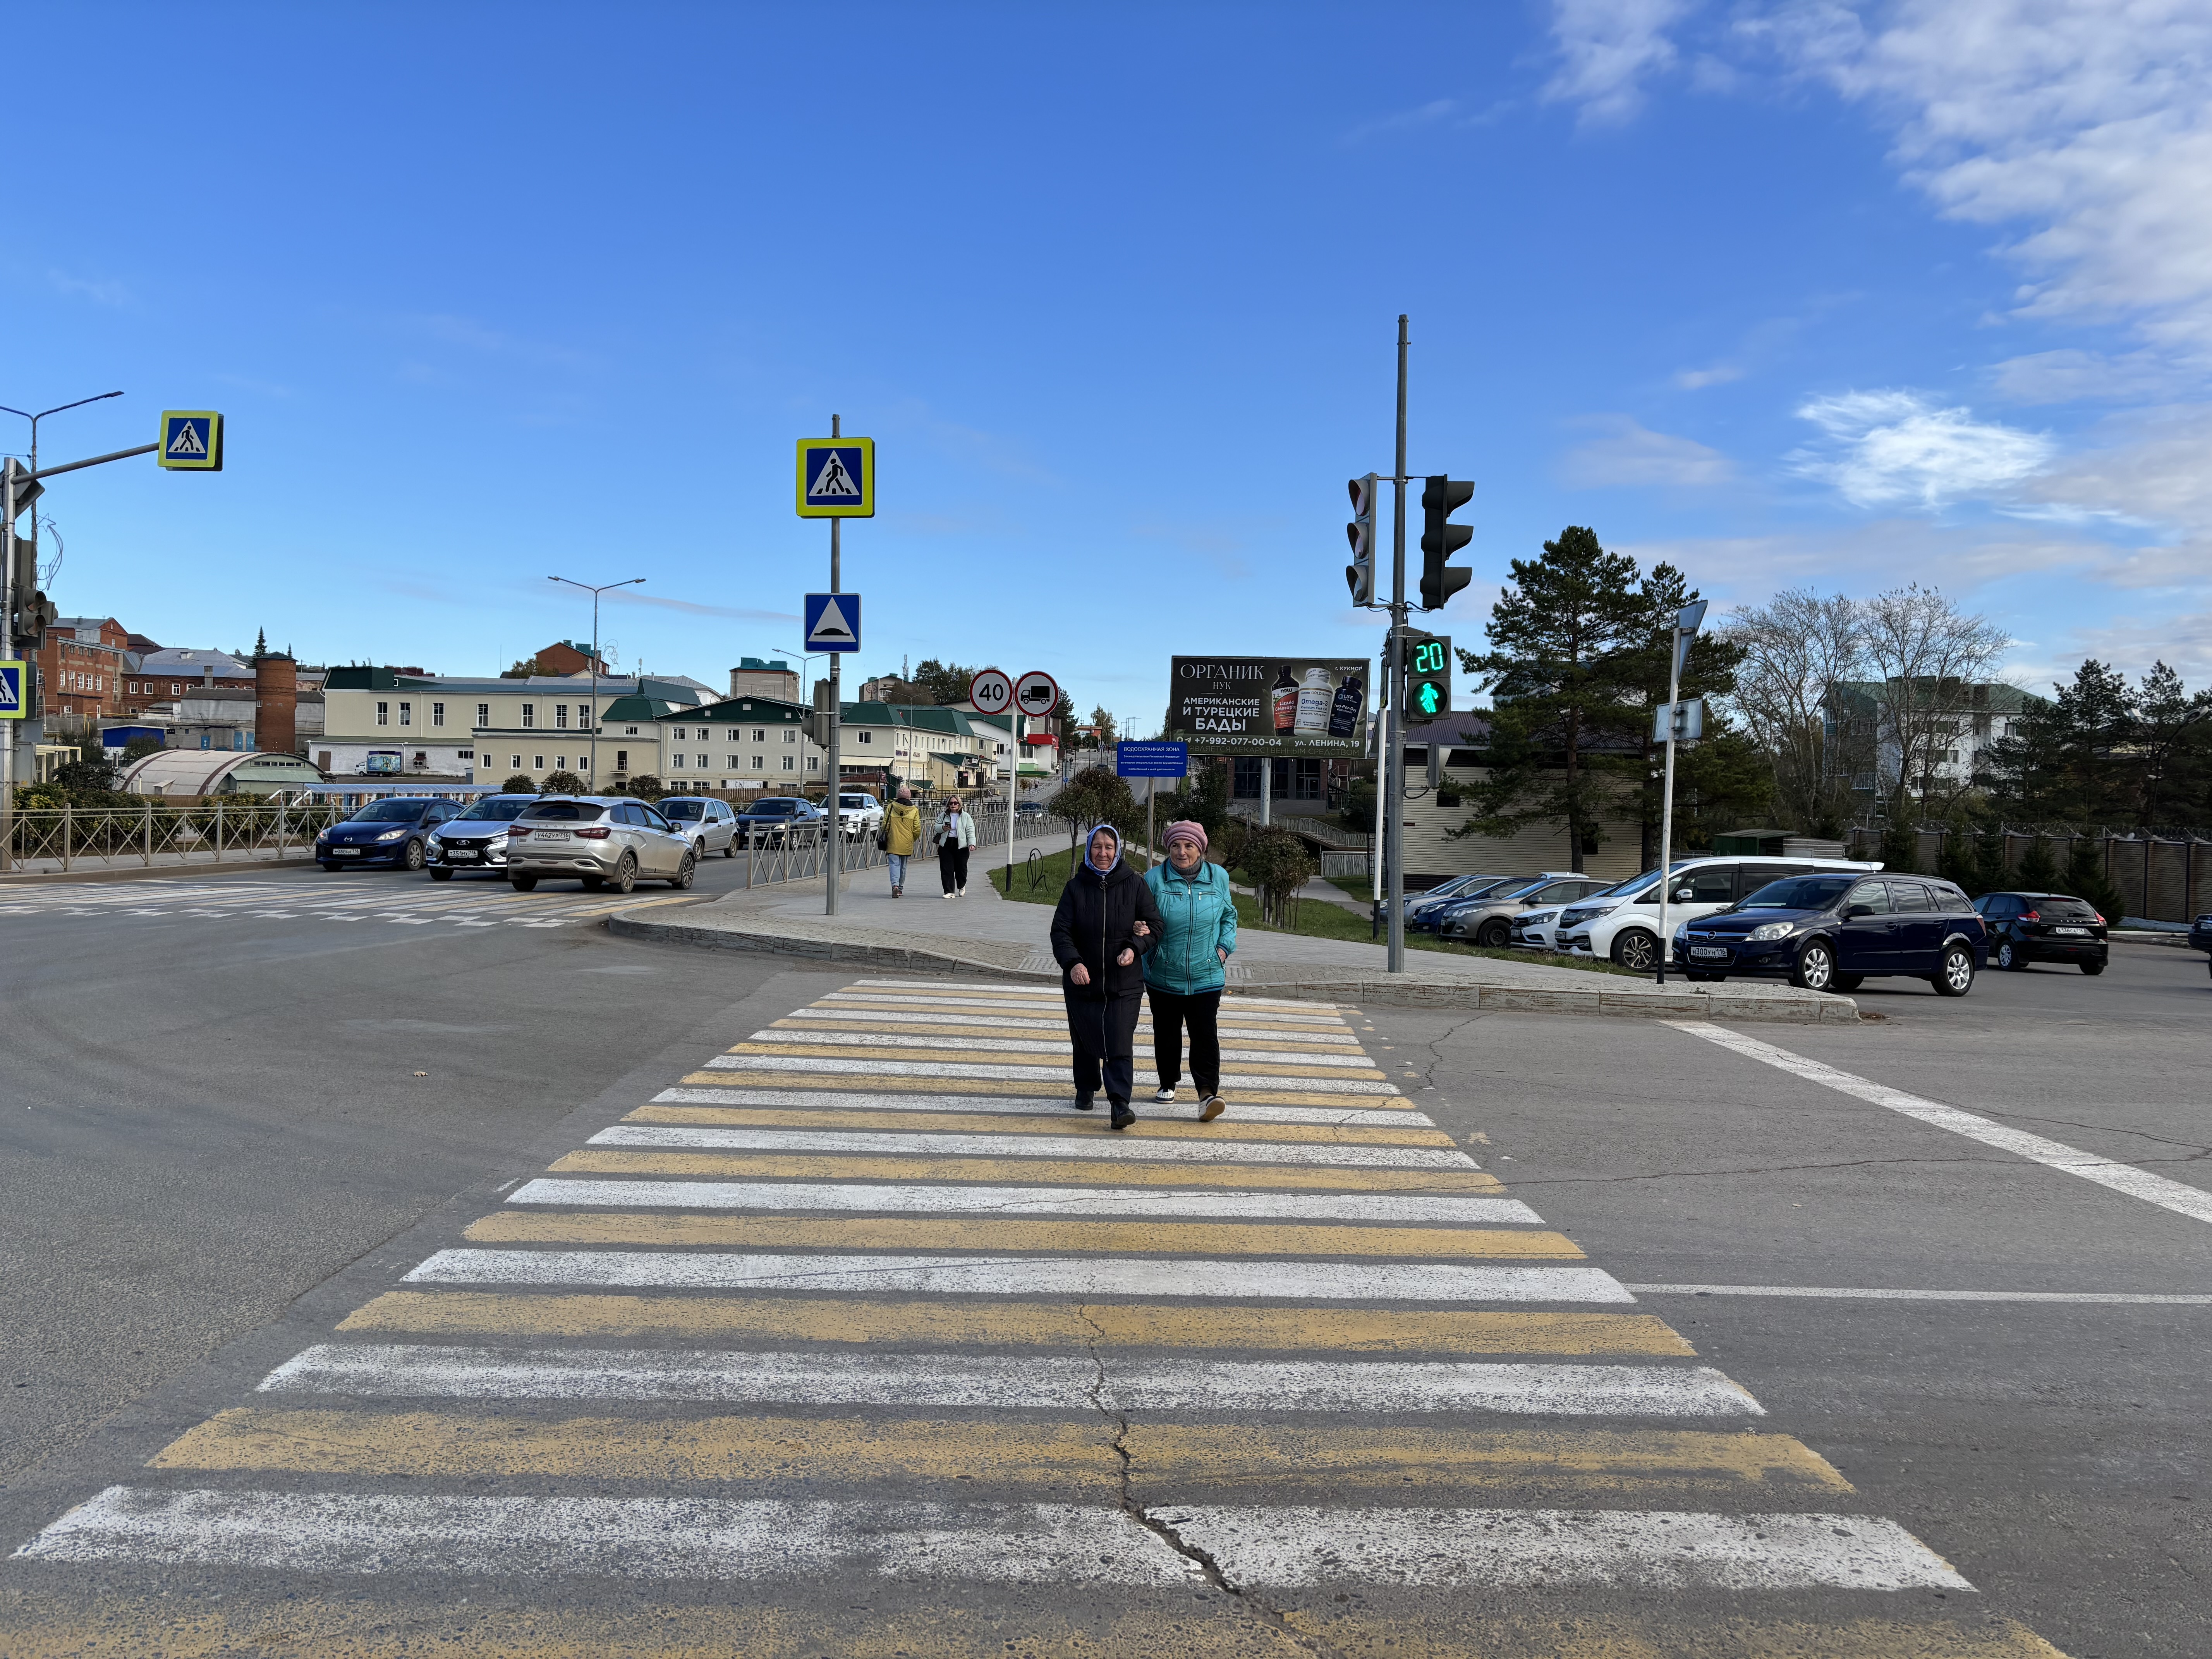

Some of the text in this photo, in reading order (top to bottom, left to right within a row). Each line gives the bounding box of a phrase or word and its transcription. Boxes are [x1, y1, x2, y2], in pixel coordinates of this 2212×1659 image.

[1416, 643, 1444, 672] 20
[1180, 664, 1265, 680] ОРГАНИК
[1213, 682, 1231, 690] НУК
[979, 684, 1004, 701] 40
[1183, 697, 1260, 706] АМЕРИКАНСКИЕ
[1183, 706, 1259, 718] И ТУРЕЦКИЕ
[1196, 718, 1246, 733] БАДЫ
[1195, 737, 1281, 746] +7-992-077-00-04
[1309, 739, 1348, 748] ЛЕНИНА,
[1233, 746, 1305, 754] ЛЕКАРСТВЕННЫМ
